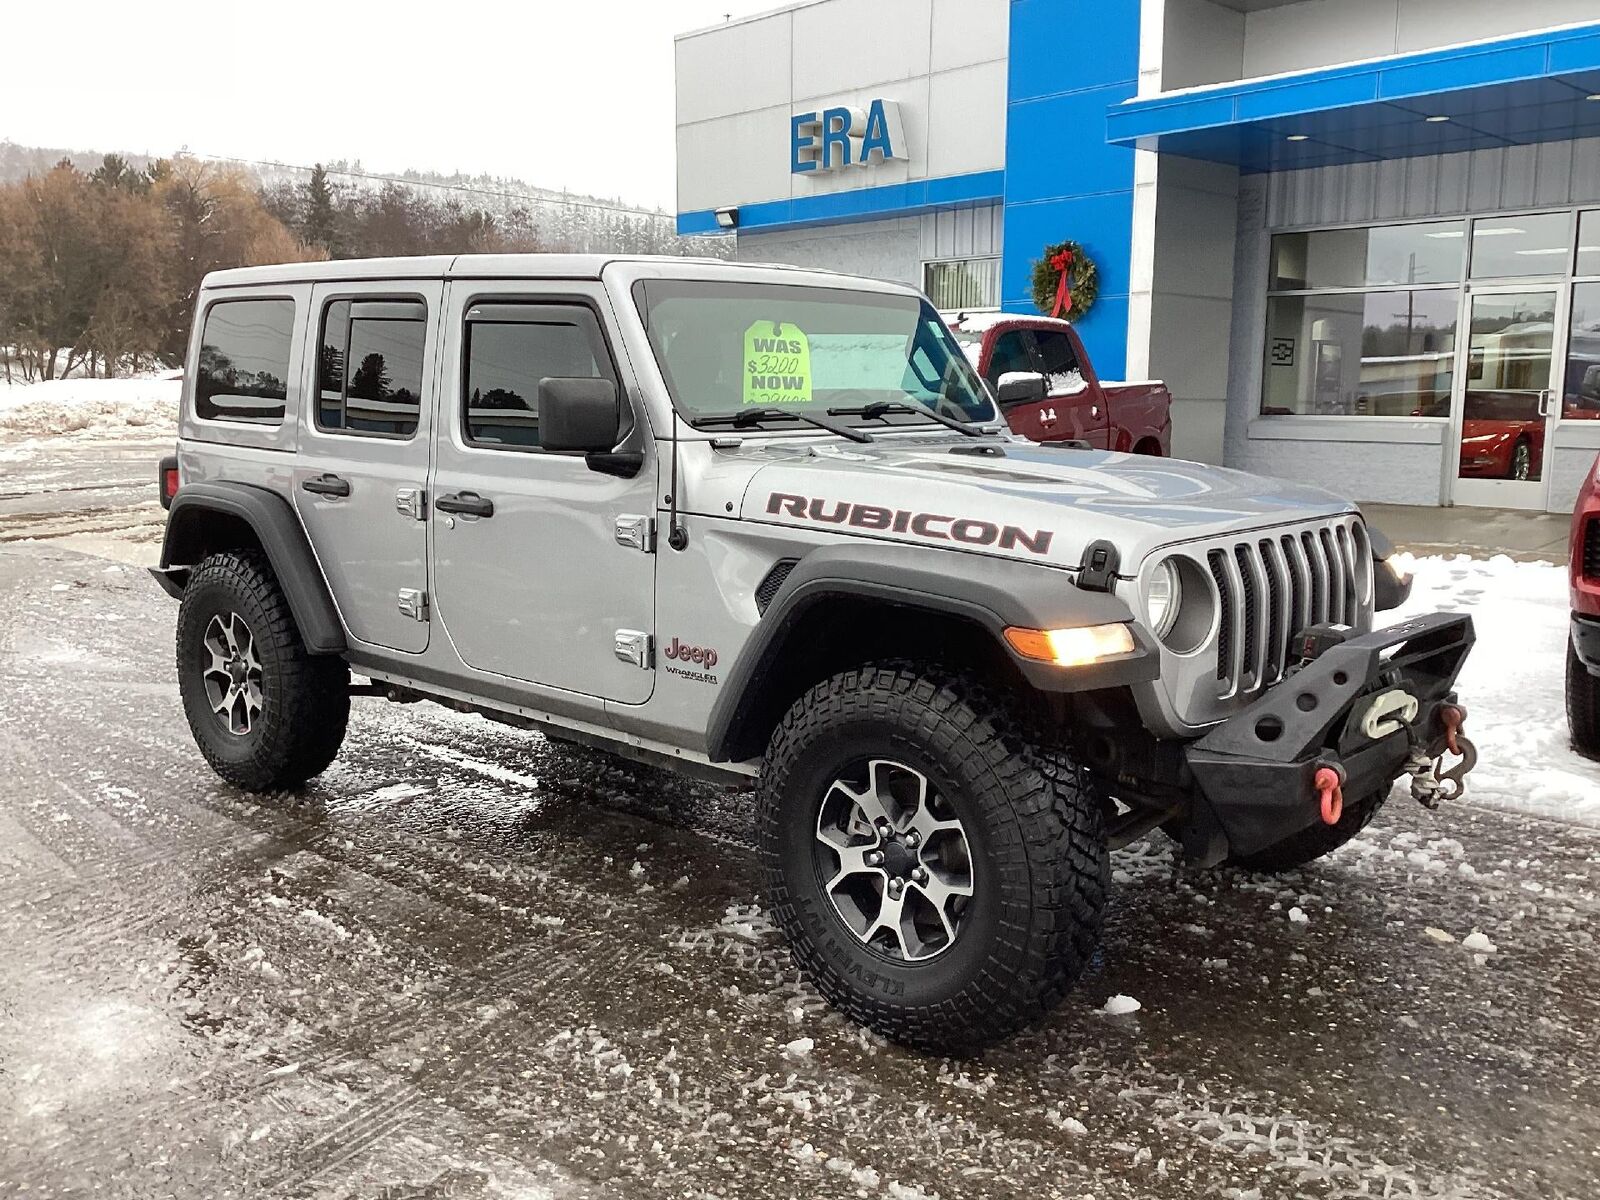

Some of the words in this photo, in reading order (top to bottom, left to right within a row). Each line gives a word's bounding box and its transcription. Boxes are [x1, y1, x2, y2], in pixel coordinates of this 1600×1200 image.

[791, 98, 894, 174] ERA
[753, 338, 801, 354] WAS
[752, 376, 804, 390] NOW
[765, 491, 1054, 555] RUBICON
[664, 637, 718, 670] Jeep
[665, 666, 718, 682] WRANGLER
